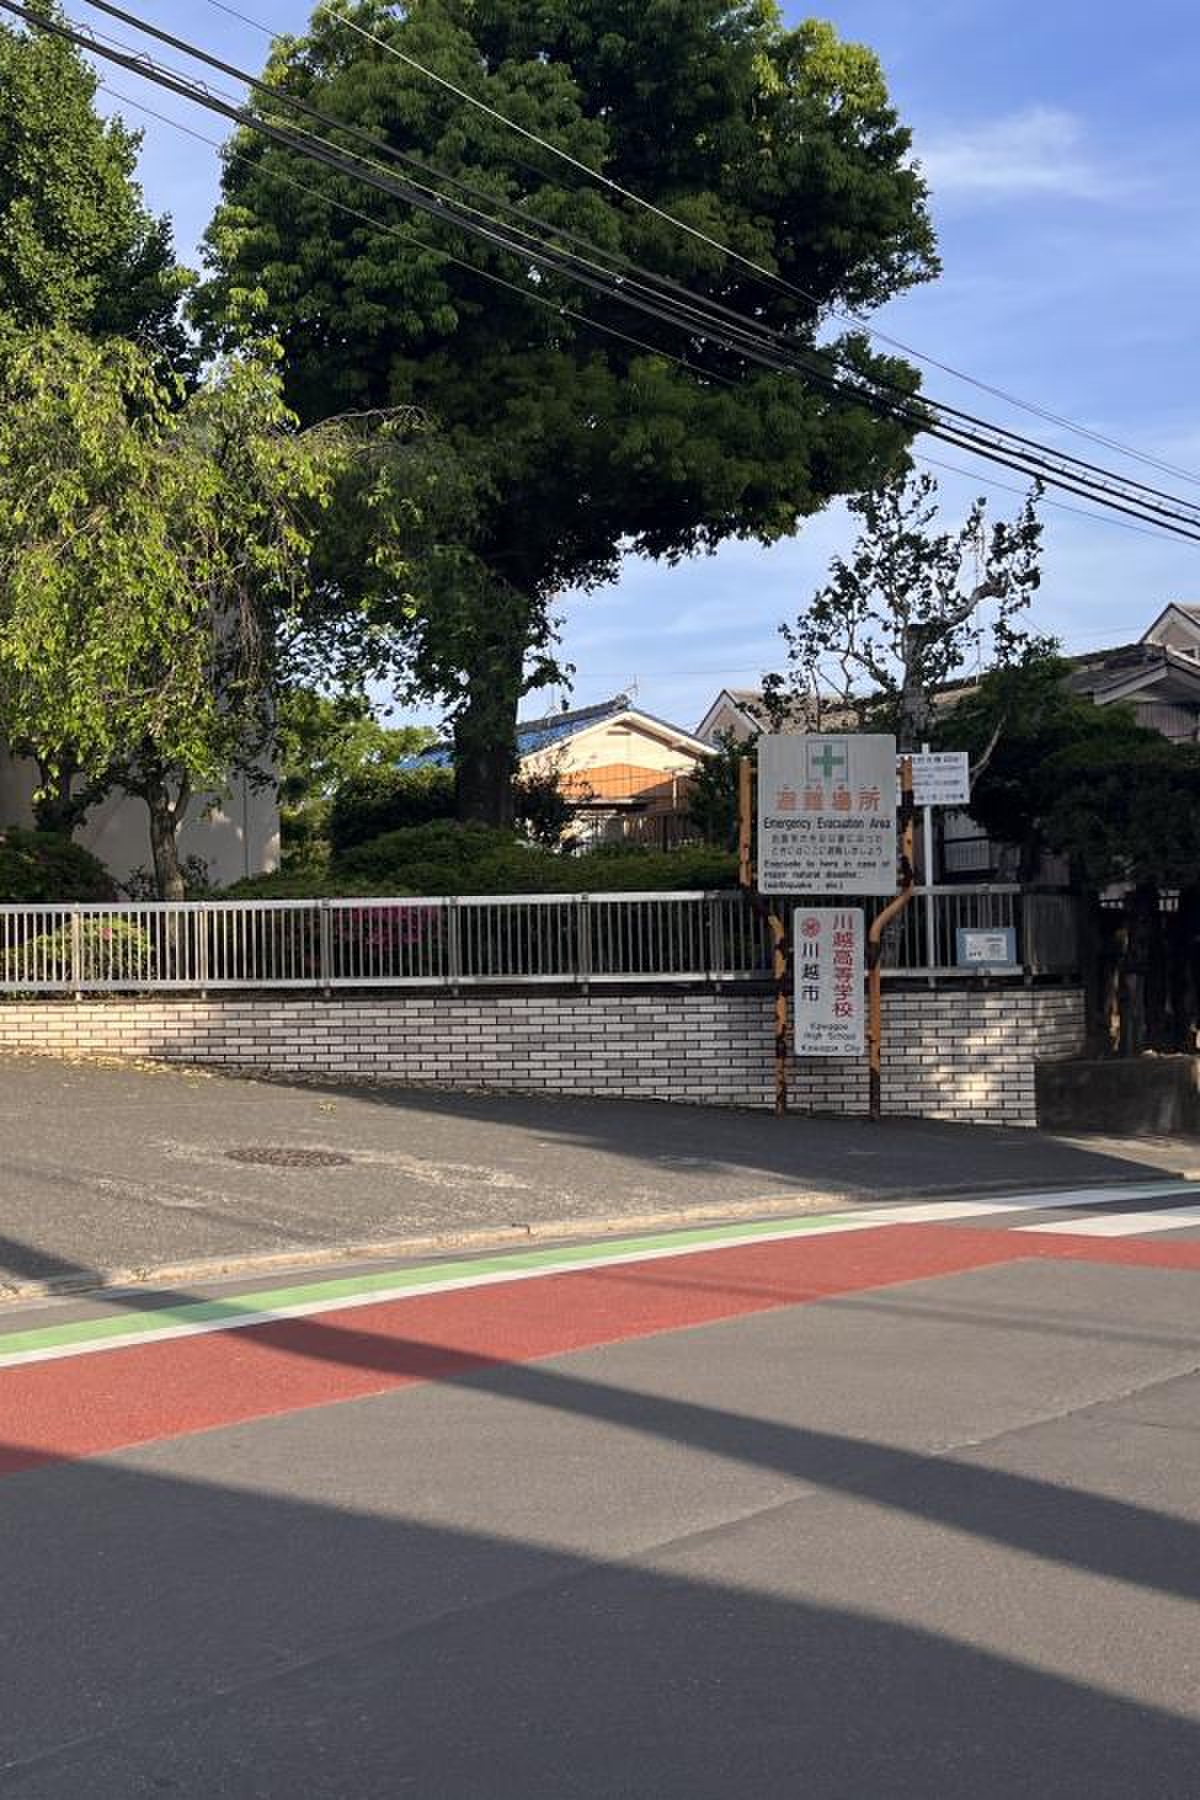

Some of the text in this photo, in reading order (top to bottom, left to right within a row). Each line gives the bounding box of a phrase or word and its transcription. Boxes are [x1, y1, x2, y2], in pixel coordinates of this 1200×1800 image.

[775, 784, 881, 811] 避難場所
[763, 817, 891, 831] Emergency Evacuation Area
[801, 943, 820, 1002] 川越市
[832, 914, 854, 1018] 川越高等学校
[809, 1023, 848, 1032] Kawagoe
[803, 1032, 857, 1041] High School
[845, 1043, 862, 1054] City
